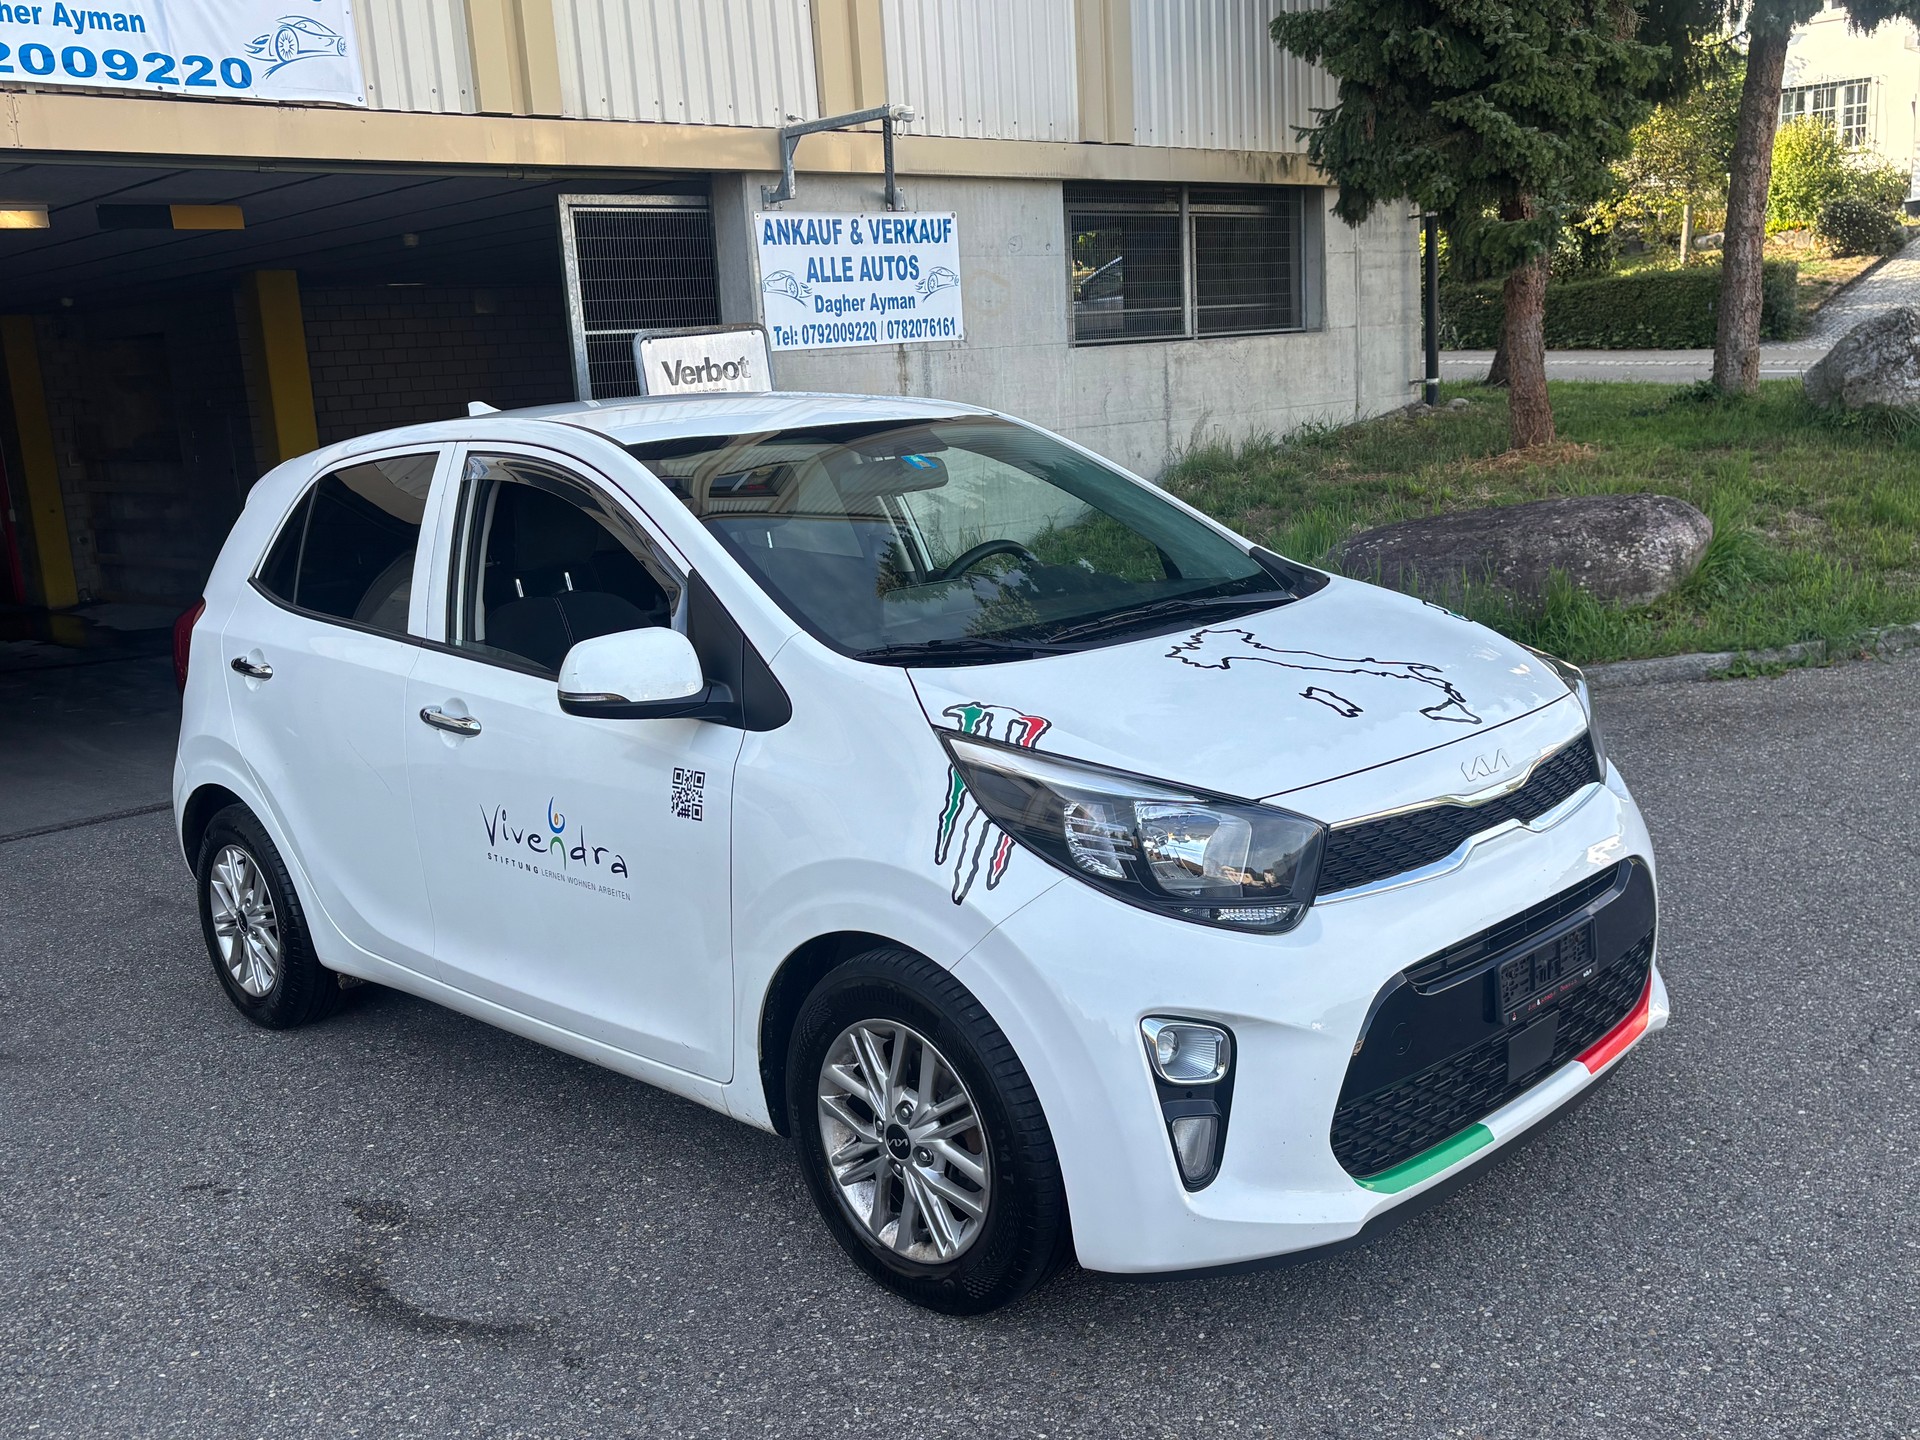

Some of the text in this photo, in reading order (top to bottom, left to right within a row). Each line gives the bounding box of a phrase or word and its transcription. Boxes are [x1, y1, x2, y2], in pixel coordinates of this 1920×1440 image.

[53, 2, 146, 34] Ayman
[763, 218, 952, 246] ANKAUF & VERKAUF
[806, 254, 920, 283] ALLE AUTOS
[814, 293, 916, 317] Dagher Ayman
[773, 325, 798, 346] Tel:
[802, 320, 877, 345] 0792009220
[887, 316, 956, 340] 0782076161
[661, 356, 752, 386] Verbot
[479, 802, 629, 879] Vivendra
[487, 852, 631, 901] STIFTUNG LERNEN WOHNEN ARBEITEN
